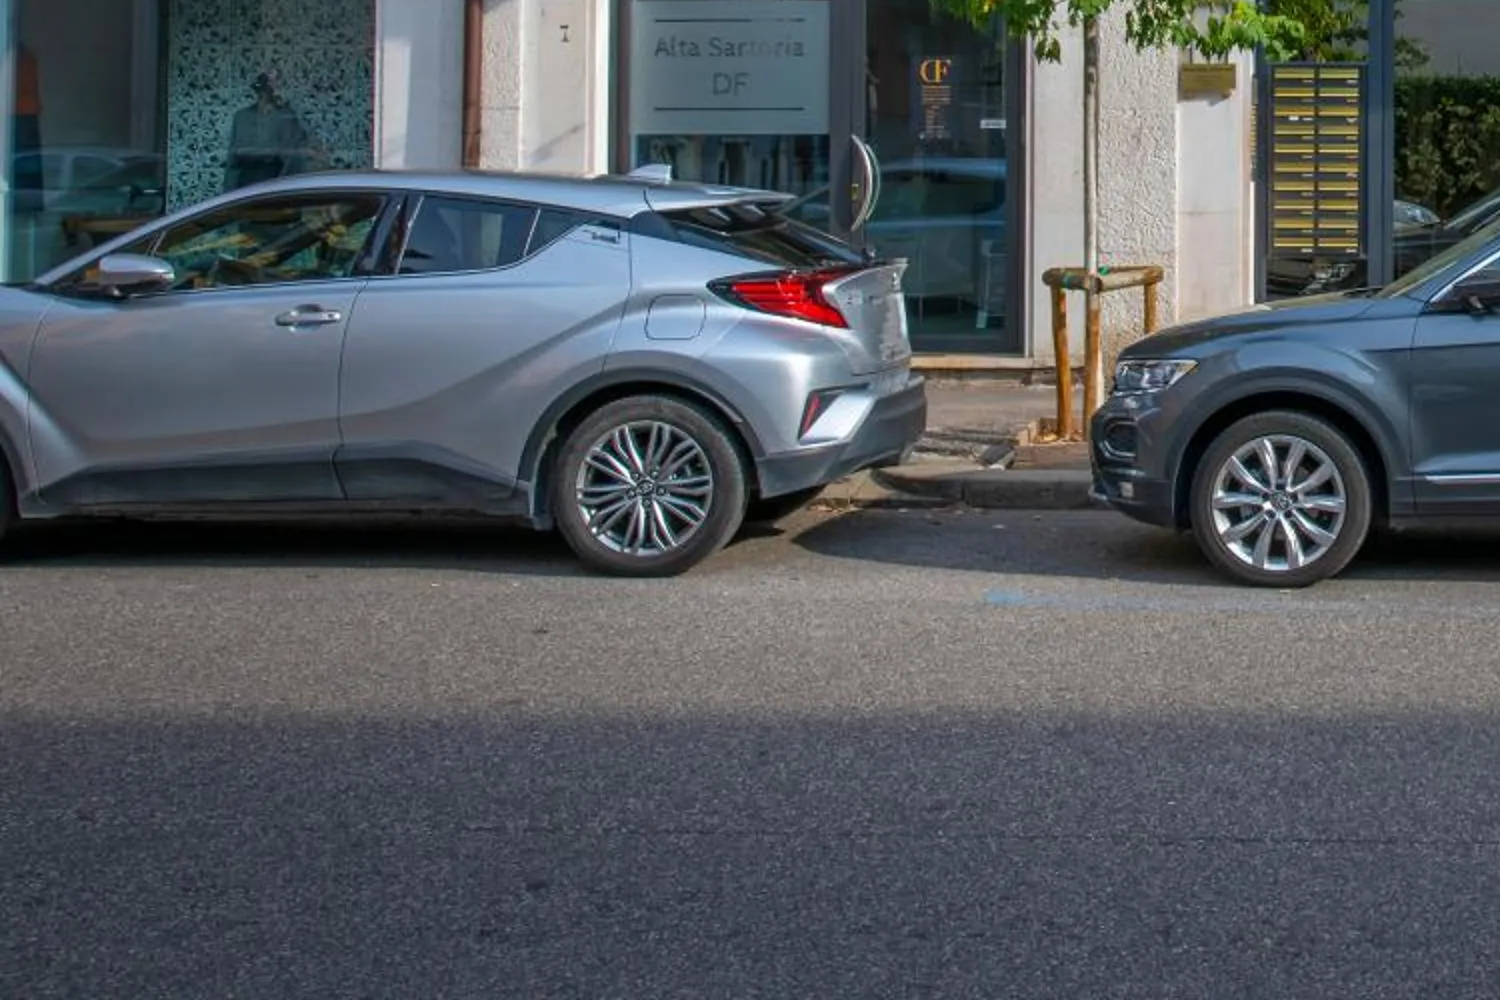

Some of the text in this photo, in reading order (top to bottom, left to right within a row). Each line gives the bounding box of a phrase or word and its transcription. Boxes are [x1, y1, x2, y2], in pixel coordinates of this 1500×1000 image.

[654, 36, 805, 57] Alta Sartoria
[712, 71, 749, 96] DF
